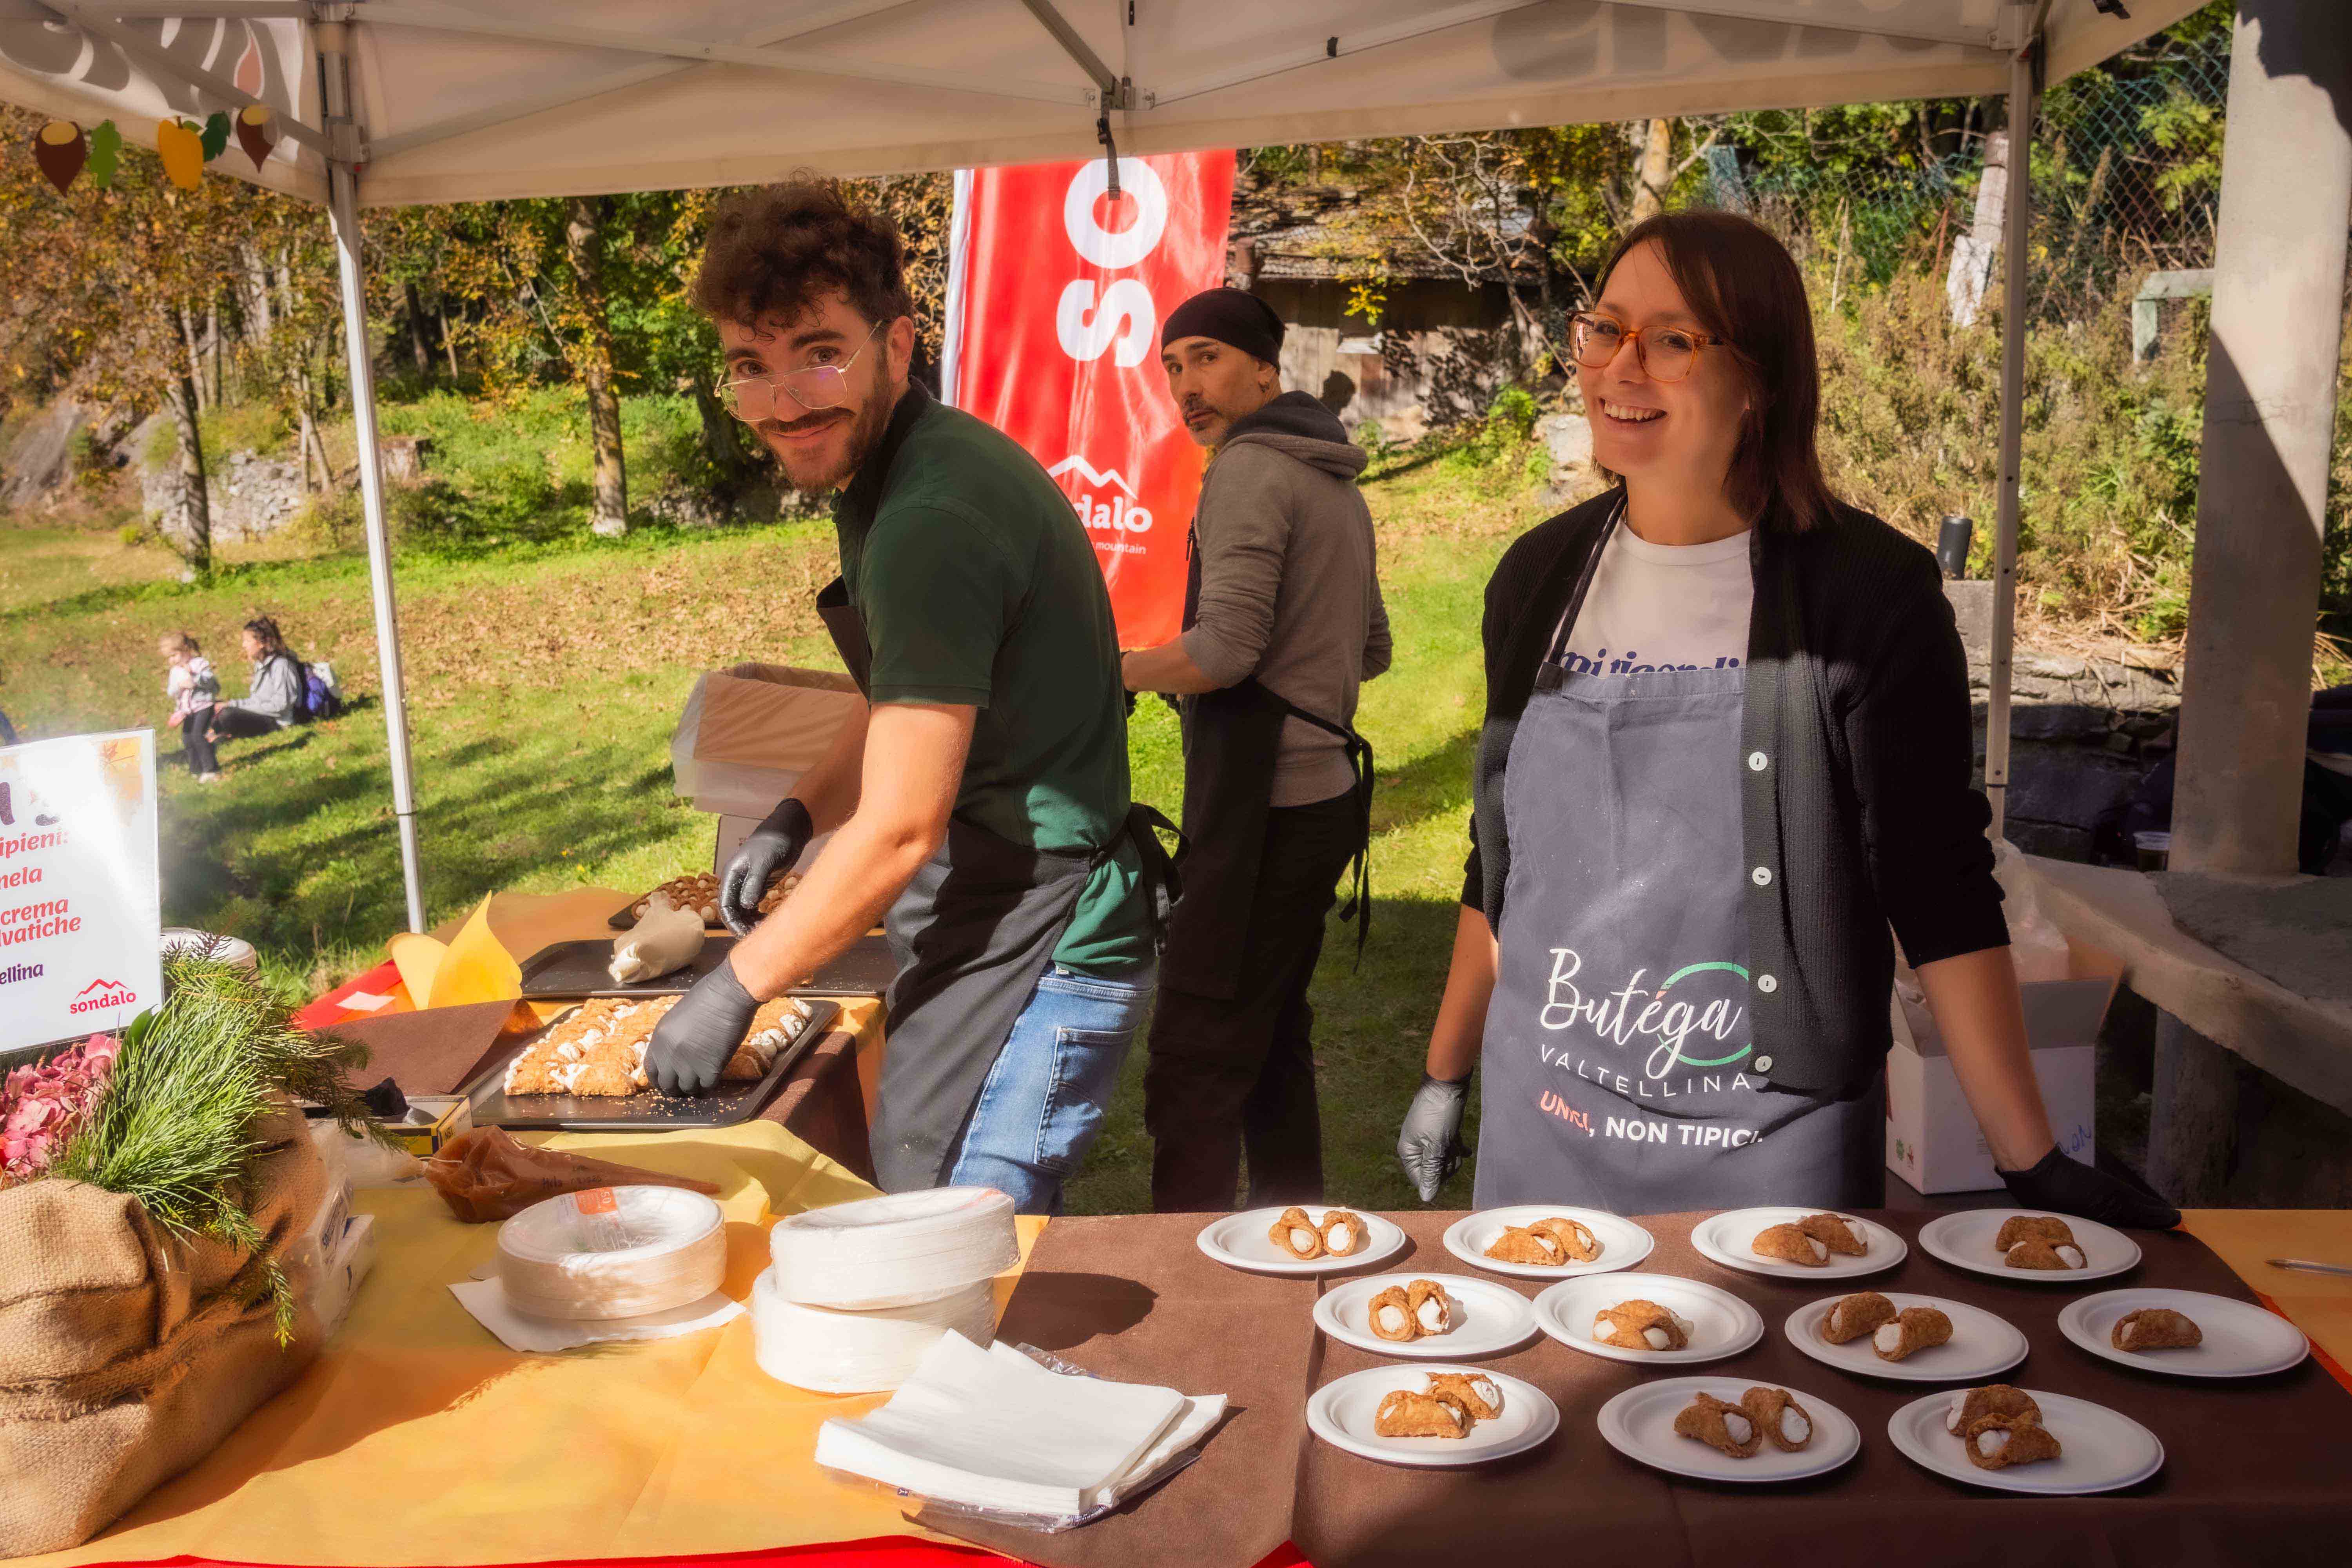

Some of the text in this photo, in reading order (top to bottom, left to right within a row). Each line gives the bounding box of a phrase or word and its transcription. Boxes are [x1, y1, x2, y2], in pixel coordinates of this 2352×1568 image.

[1073, 494, 1152, 533] dalo
[1096, 541, 1146, 555] mountain
[1, 899, 68, 925] crema
[70, 991, 136, 1014] sondalo
[1542, 1044, 1751, 1097] VALTELLINA
[1606, 1116, 1668, 1143] NON
